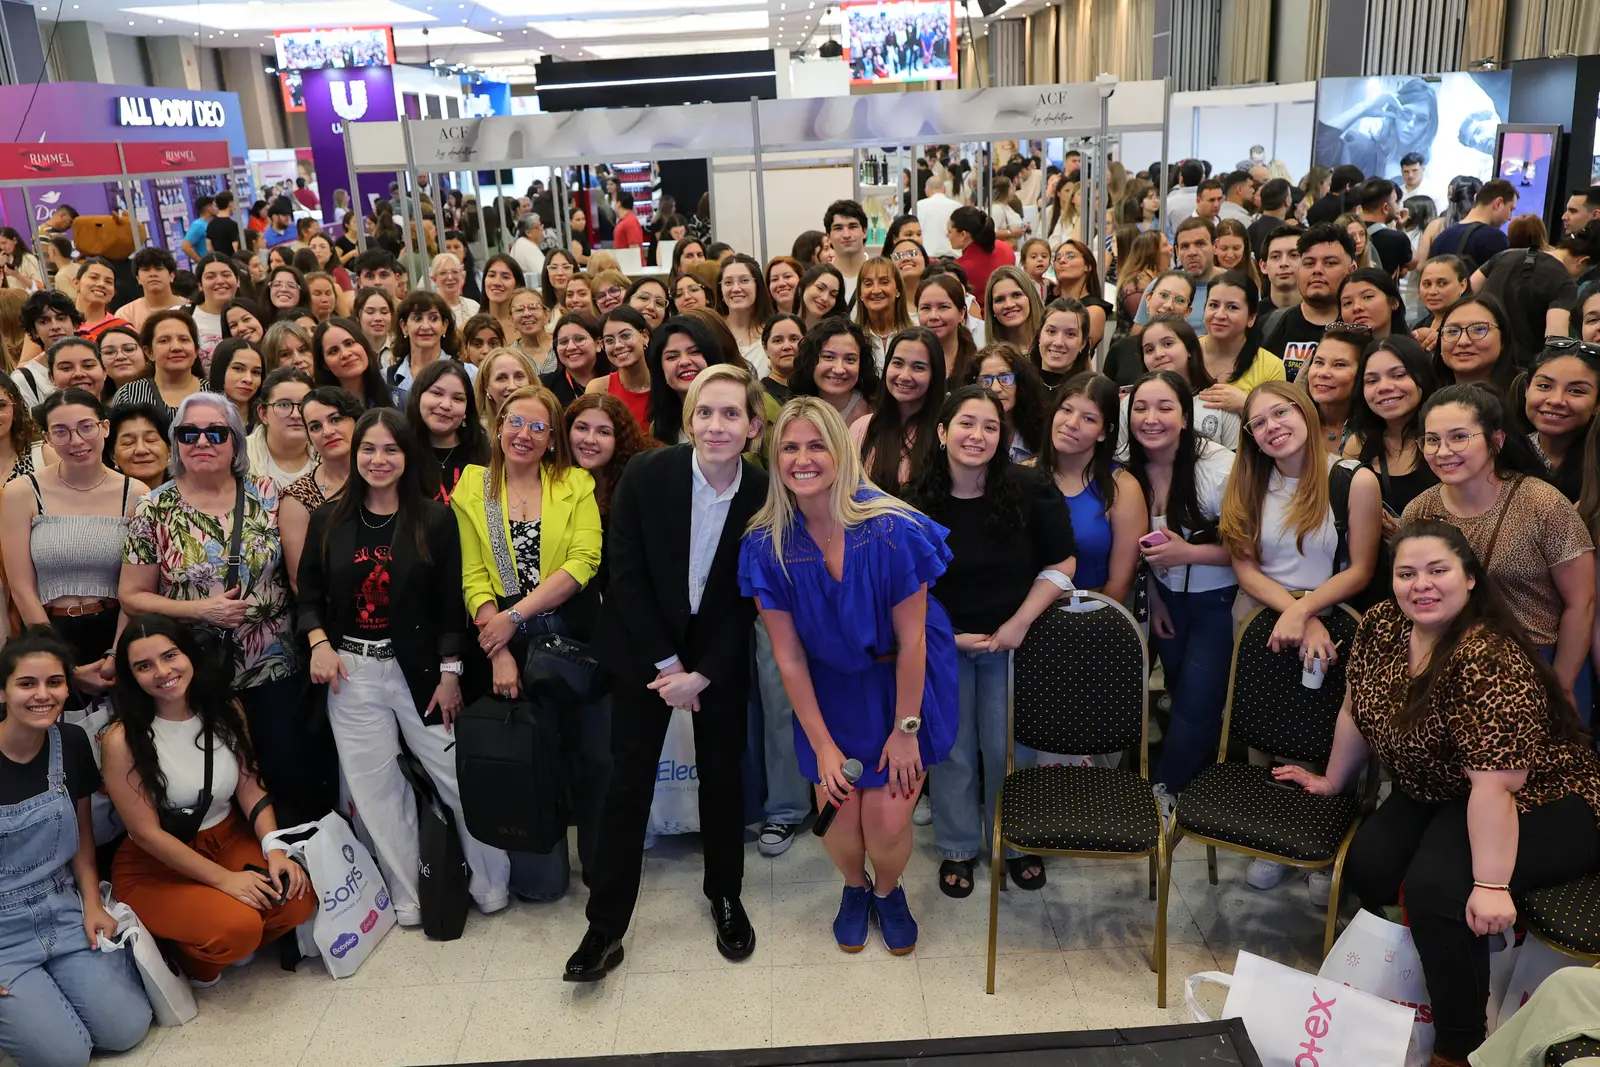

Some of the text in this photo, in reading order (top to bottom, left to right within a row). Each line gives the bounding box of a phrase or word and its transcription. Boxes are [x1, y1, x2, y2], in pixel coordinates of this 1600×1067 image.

[1037, 92, 1067, 105] ACF
[120, 96, 225, 127] ALL BODY DEO
[438, 126, 468, 139] ACF
[29, 153, 72, 165] RIMMEL
[165, 150, 195, 161] RIMMEL
[332, 935, 357, 955] Babysec
